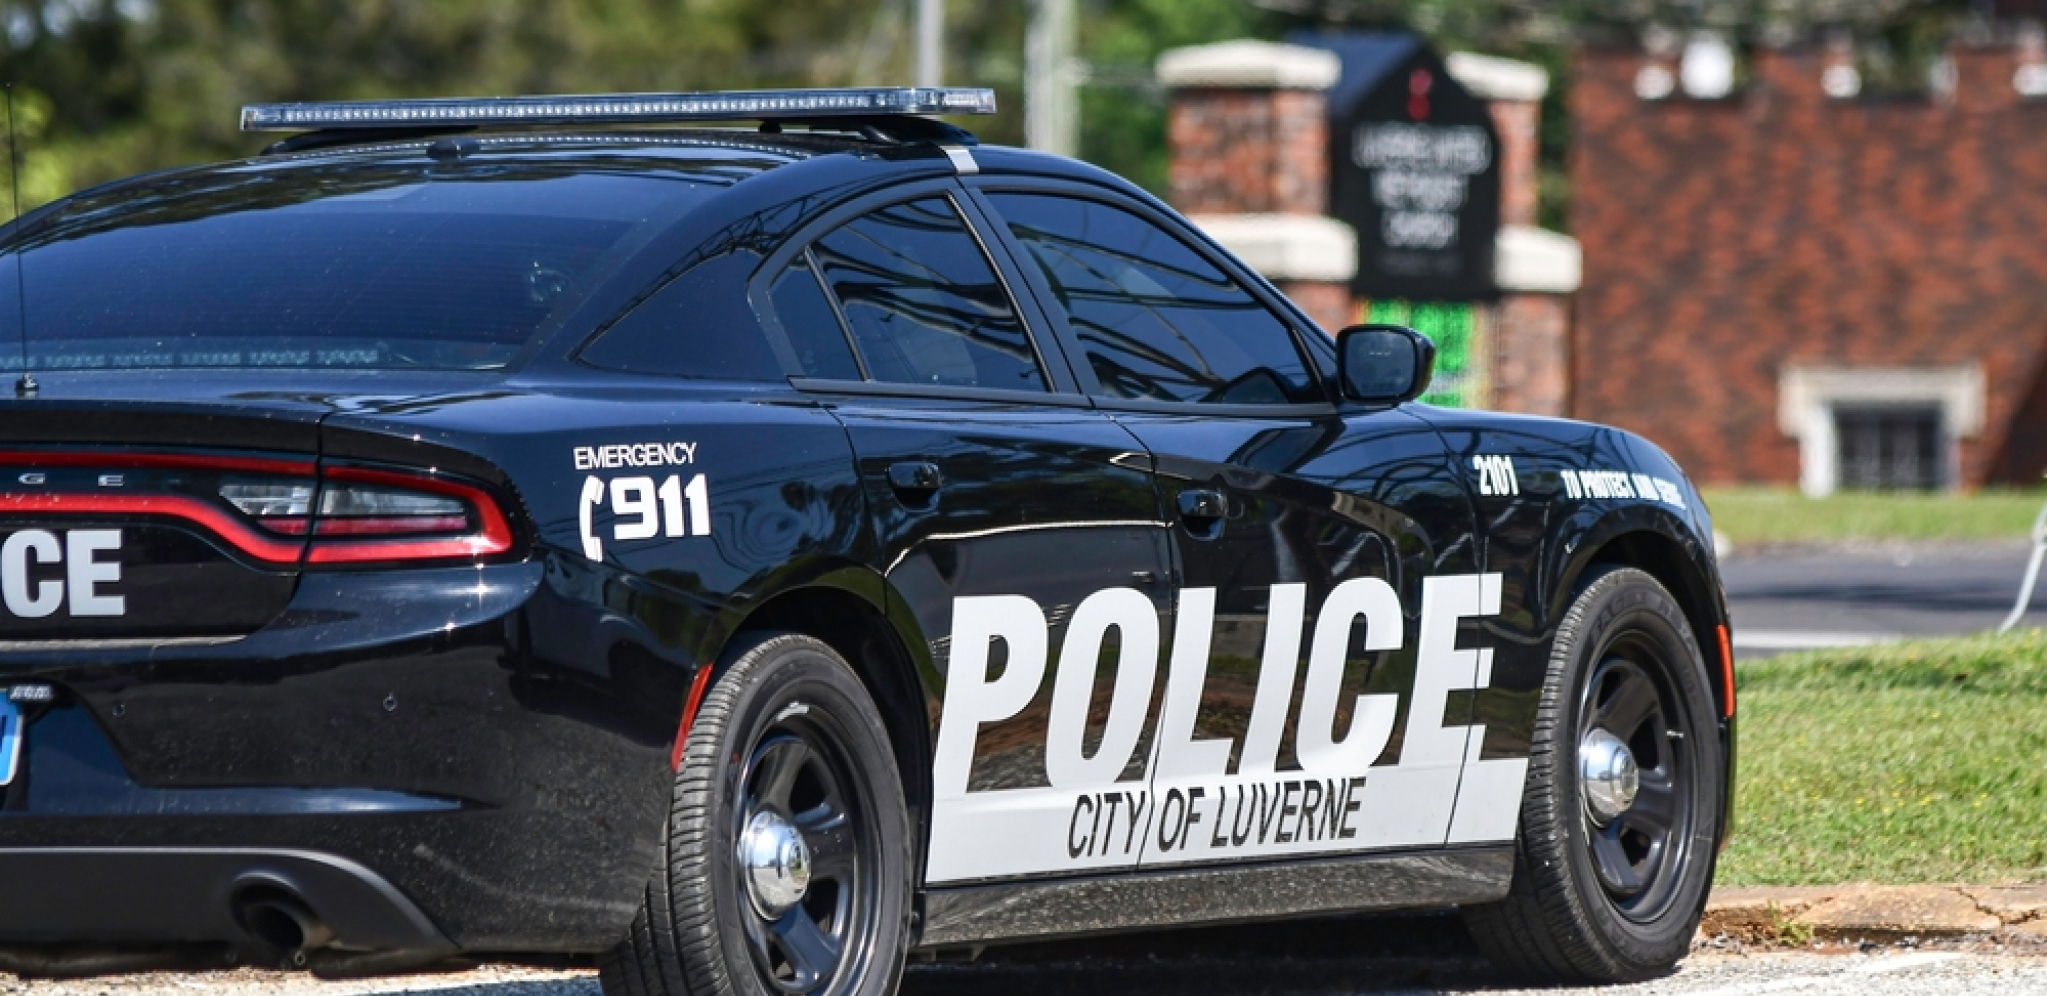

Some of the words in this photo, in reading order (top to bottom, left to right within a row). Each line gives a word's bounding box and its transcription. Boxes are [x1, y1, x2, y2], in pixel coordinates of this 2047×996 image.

[573, 441, 697, 470] EMERGENCY
[1472, 454, 1519, 496] 2101
[609, 473, 711, 540] 911
[1560, 468, 1582, 499] TO
[1579, 469, 1636, 499] PROTECT
[933, 572, 1503, 794] POLICE
[1067, 790, 1146, 858] CITY
[1157, 786, 1206, 852] OF
[1209, 776, 1367, 848] LUVERNE
